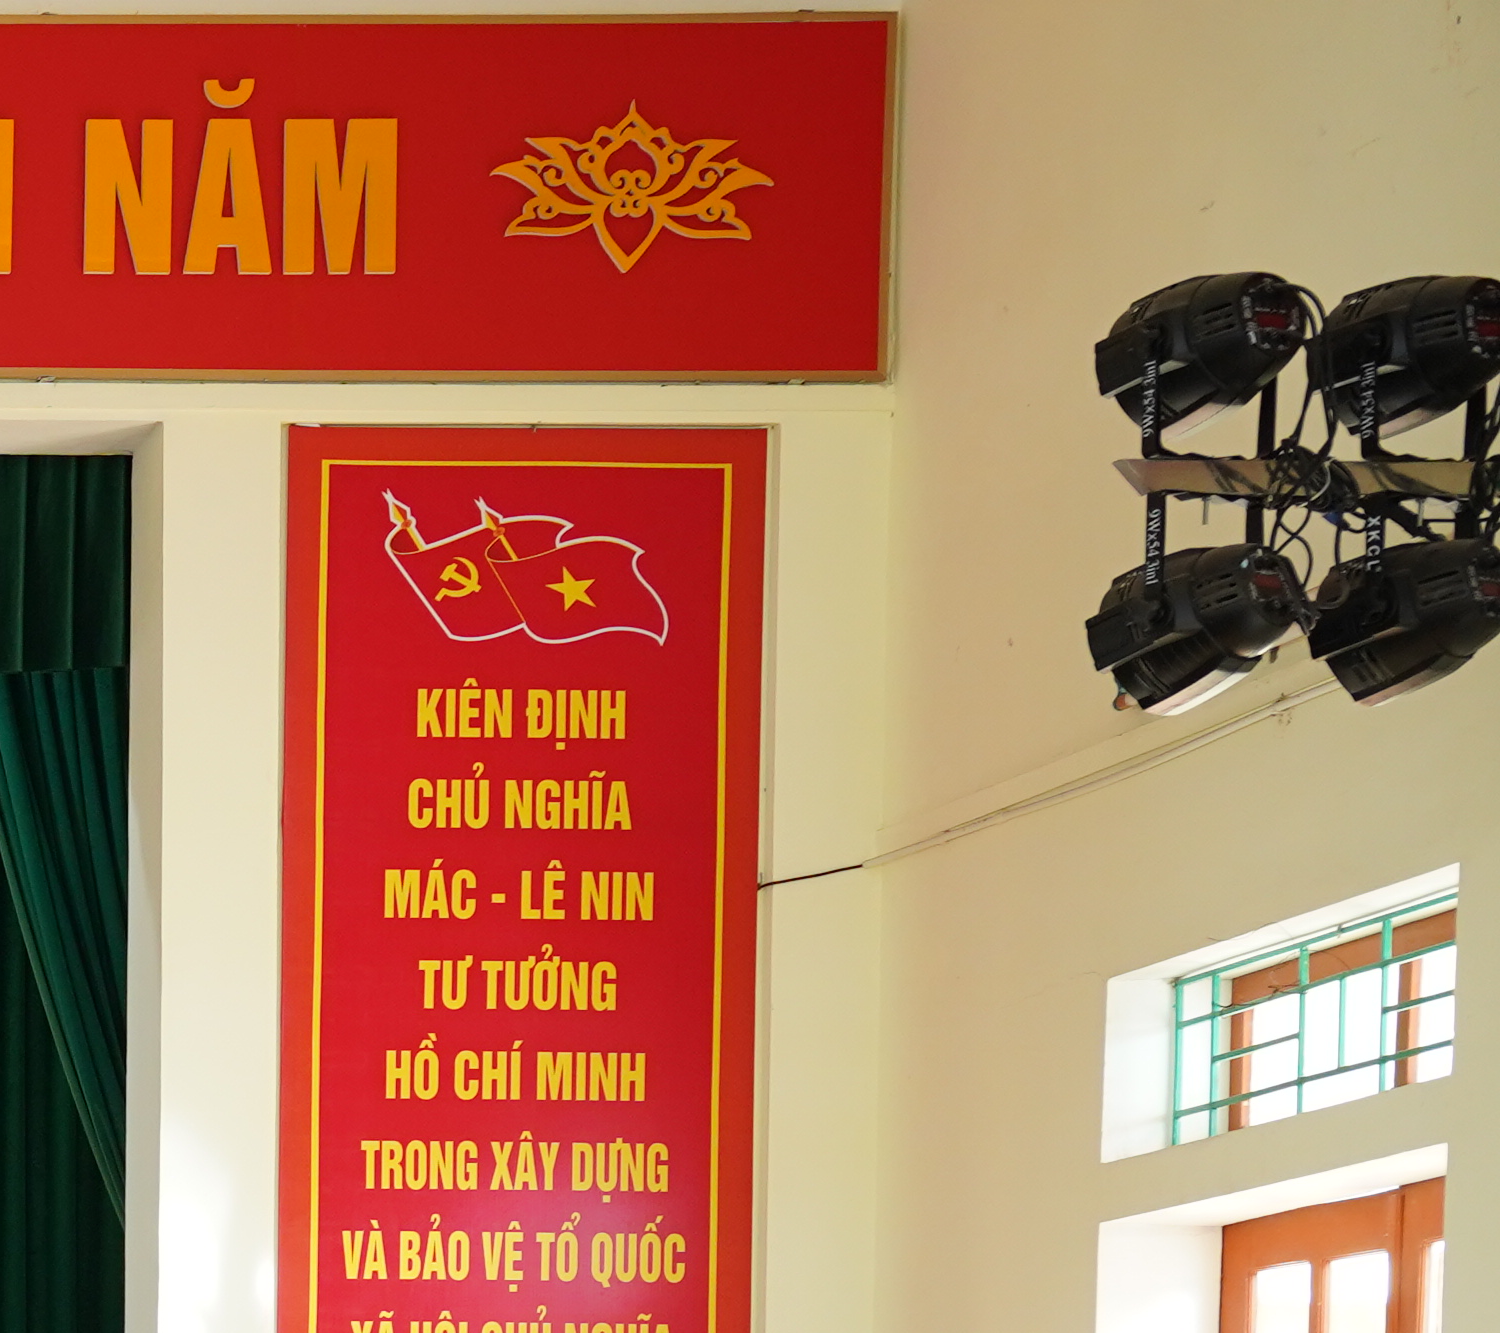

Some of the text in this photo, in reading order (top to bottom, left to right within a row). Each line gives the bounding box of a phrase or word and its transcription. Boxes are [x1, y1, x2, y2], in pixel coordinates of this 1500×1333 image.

[83, 79, 397, 275] NĂM
[417, 678, 625, 750] KIÊN ĐỊNH
[408, 762, 631, 830] CHỦ NGHĨA
[384, 859, 654, 920] MÁC - LÊ NIN
[419, 944, 616, 1011] TƯ TƯỞNG
[385, 1033, 645, 1101] HỒ CHÍ MINH
[361, 1131, 668, 1202] TRONG XÂY DỰNG
[342, 1212, 685, 1292] VÀ BẢO VỆ TỔ QUỐC
